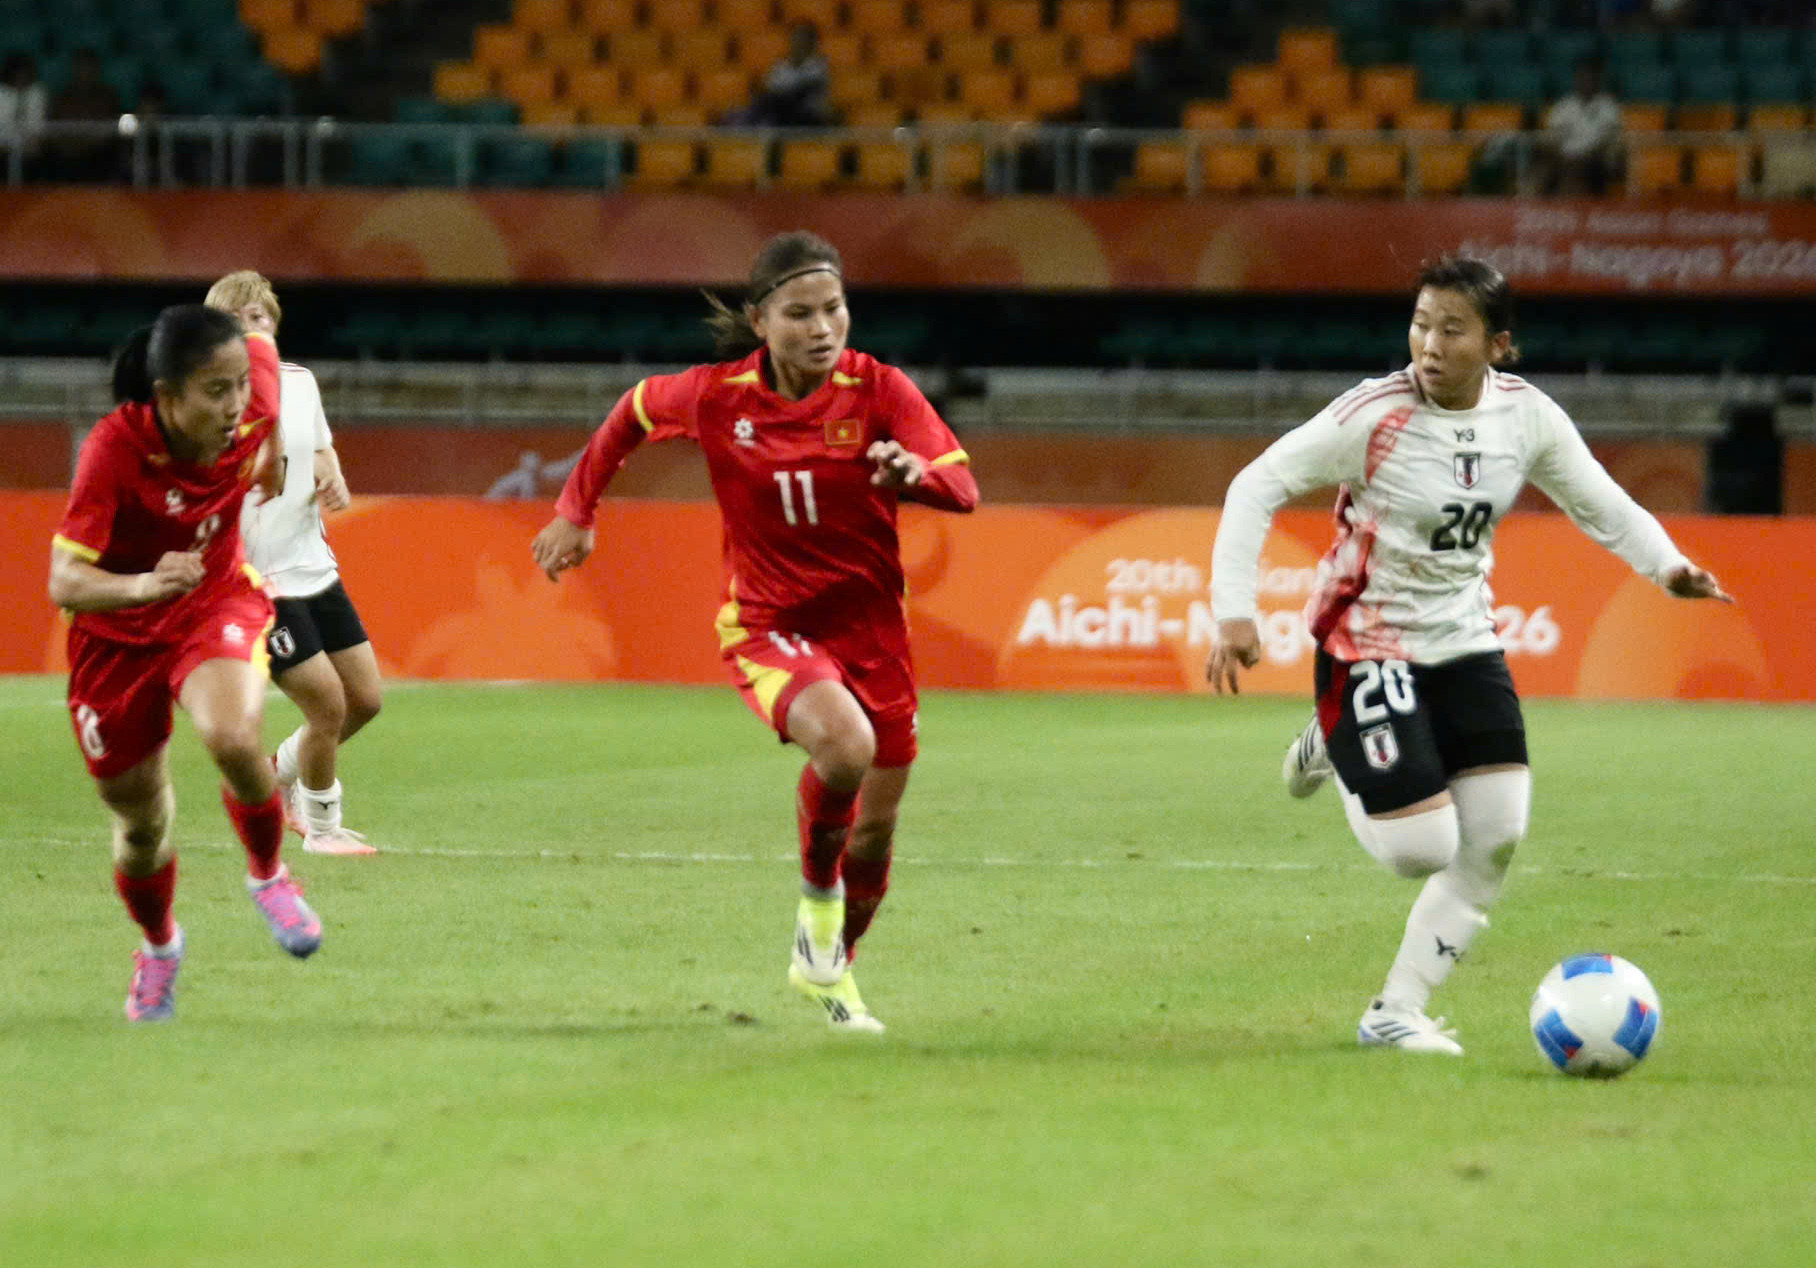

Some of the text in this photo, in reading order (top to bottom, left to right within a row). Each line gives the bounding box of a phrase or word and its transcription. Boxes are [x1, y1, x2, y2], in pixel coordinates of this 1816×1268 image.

[1453, 427, 1476, 443] Y-3
[773, 470, 819, 527] 11
[1430, 501, 1493, 551] 20
[1106, 557, 1202, 592] 20th
[1494, 604, 1563, 655] 26
[1349, 659, 1417, 723] 20
